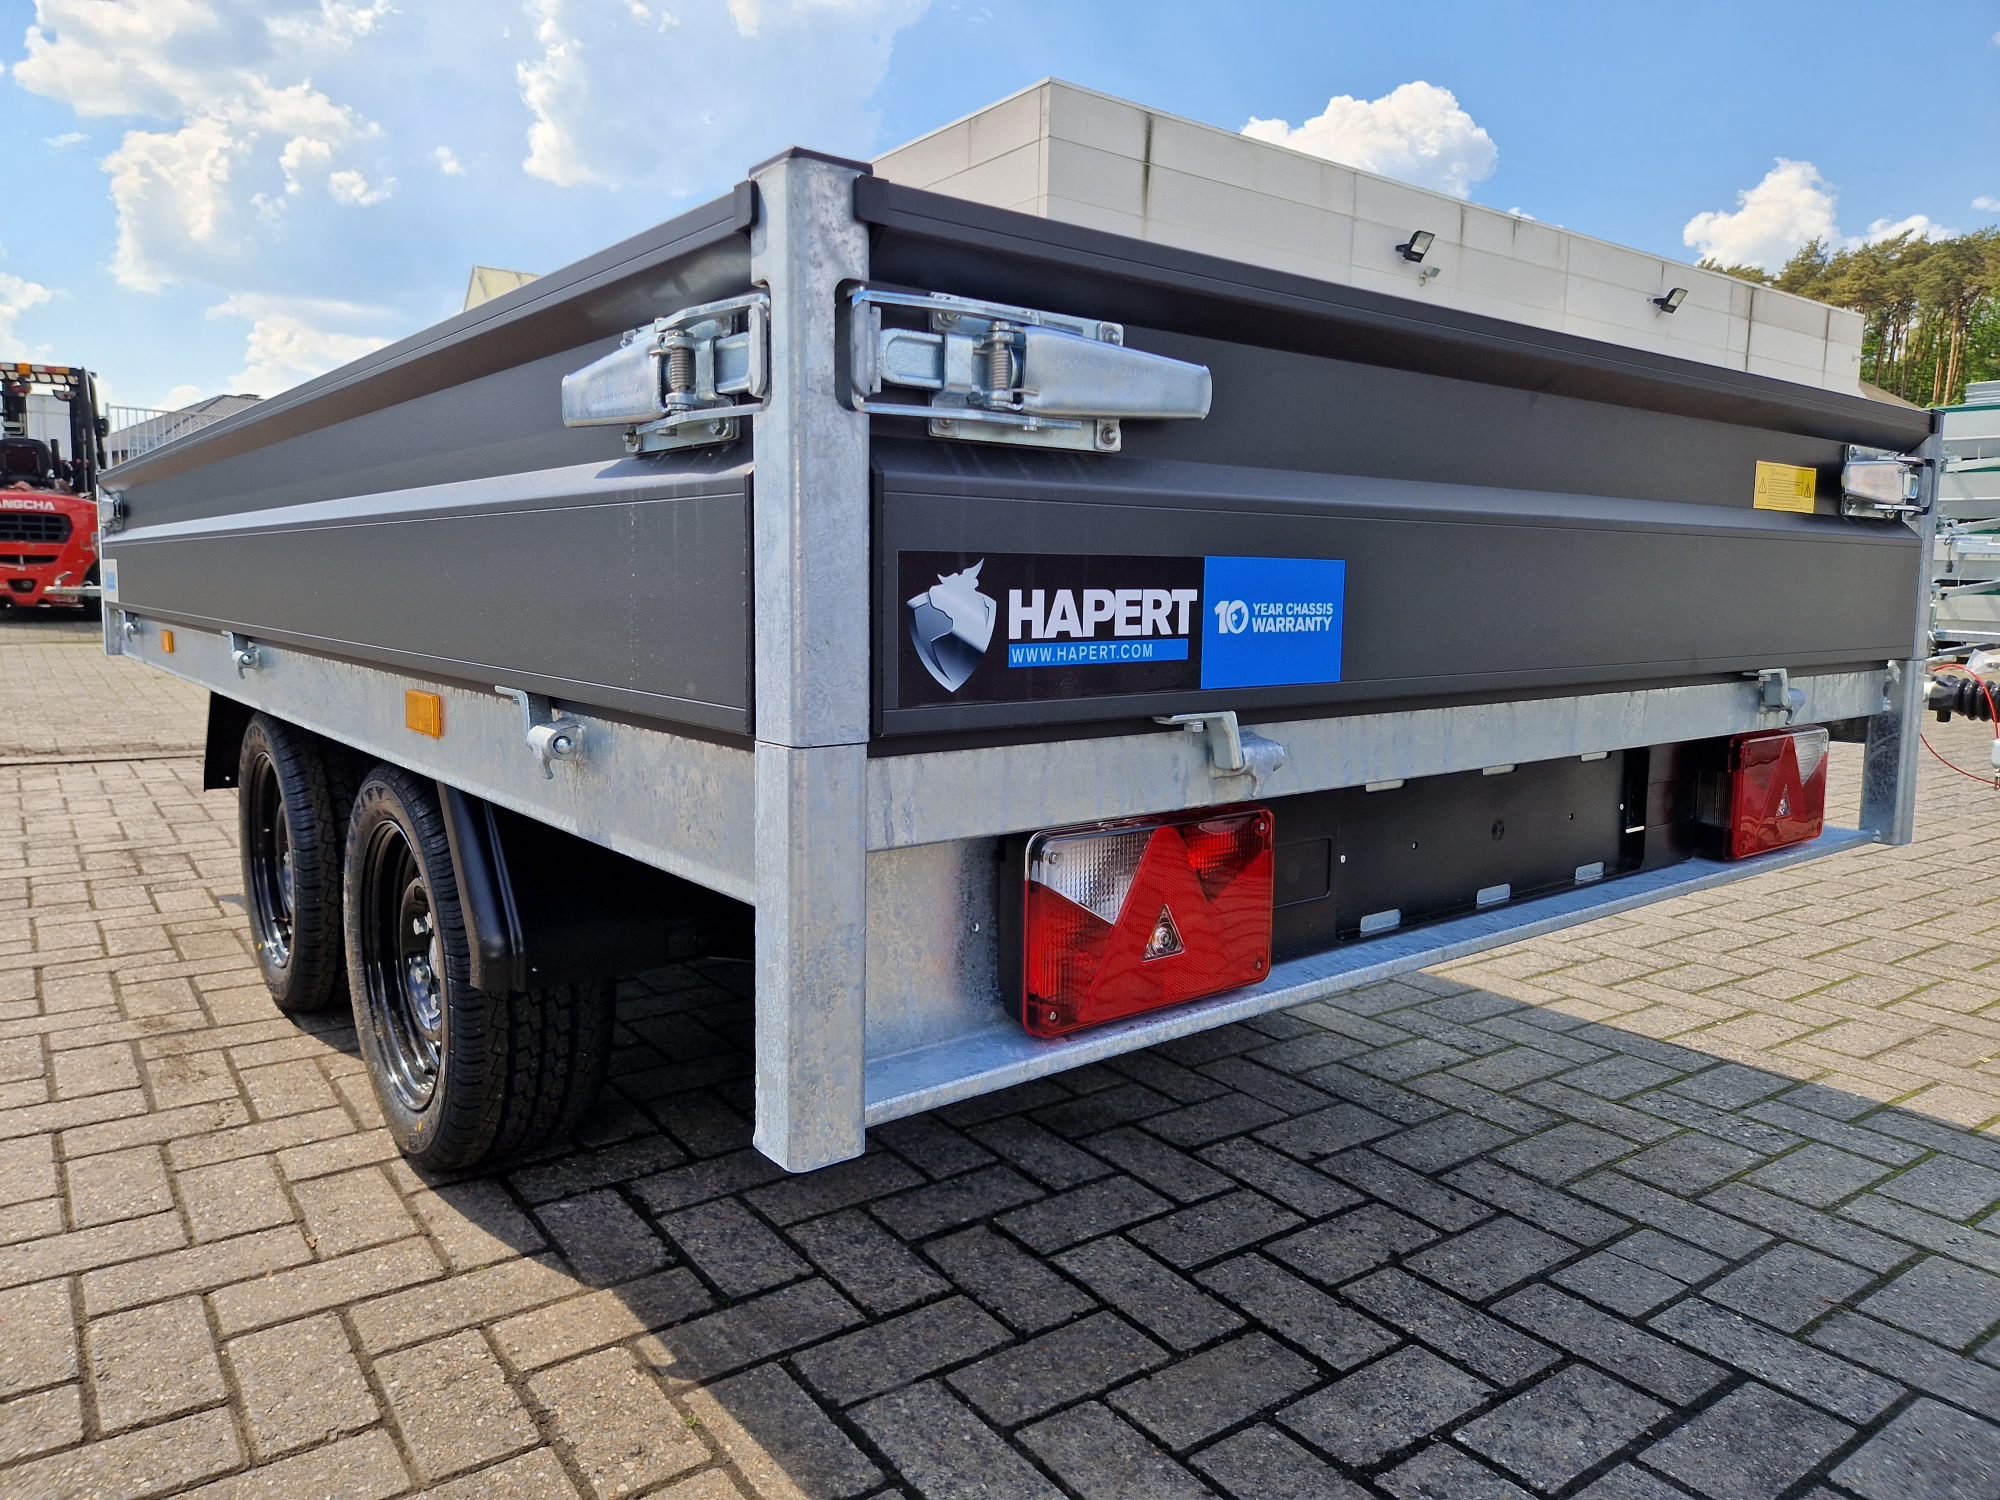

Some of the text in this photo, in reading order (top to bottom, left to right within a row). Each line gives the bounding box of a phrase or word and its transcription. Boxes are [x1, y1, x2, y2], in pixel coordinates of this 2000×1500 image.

[0, 498, 56, 511] NGCHA
[1008, 588, 1198, 640] HAPERT
[1213, 599, 1250, 635] 10
[1252, 602, 1334, 616] YEAR CHASSIS
[1251, 616, 1333, 633] WARRANTY
[1011, 643, 1153, 663] WWW.HAPERT.COM
